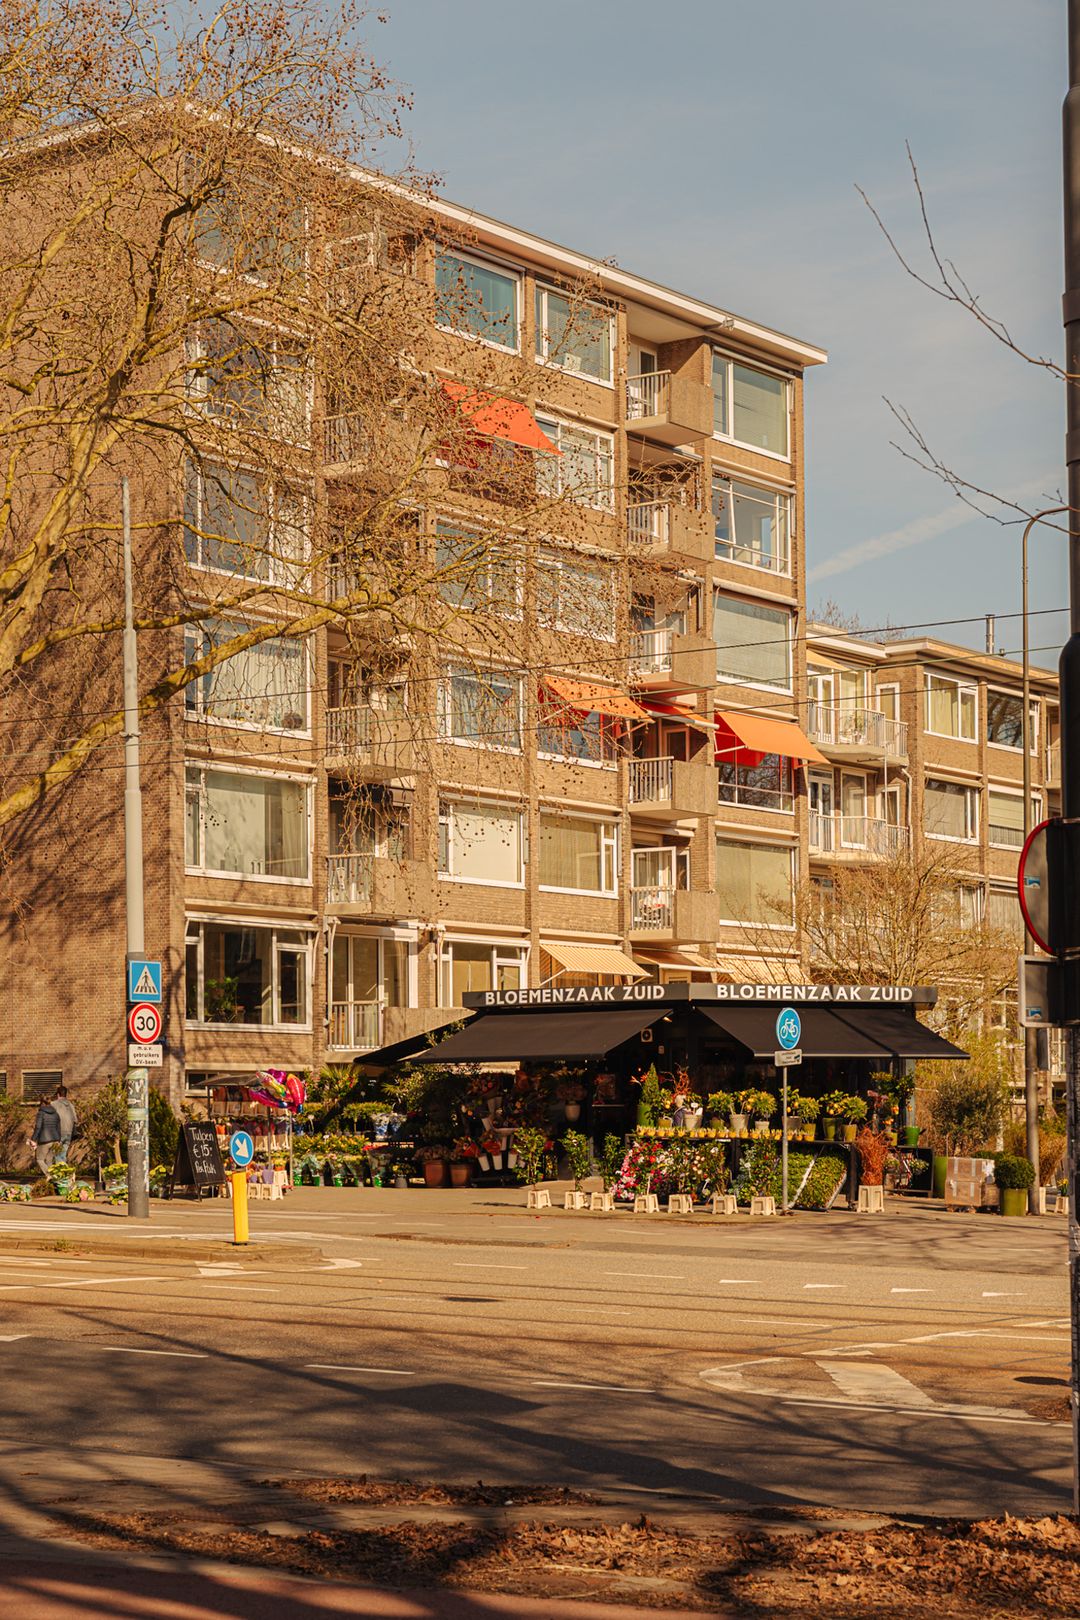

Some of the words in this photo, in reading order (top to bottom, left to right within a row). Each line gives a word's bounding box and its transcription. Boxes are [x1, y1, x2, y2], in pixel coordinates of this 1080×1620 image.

[485, 986, 615, 1005] BLOEMENZAAK
[623, 985, 665, 1000] ZUID
[717, 984, 862, 1000] BLOEMENZAAK
[869, 986, 913, 1001] ZUID
[136, 1016, 156, 1031] 30
[188, 1127, 214, 1144] Tulpen
